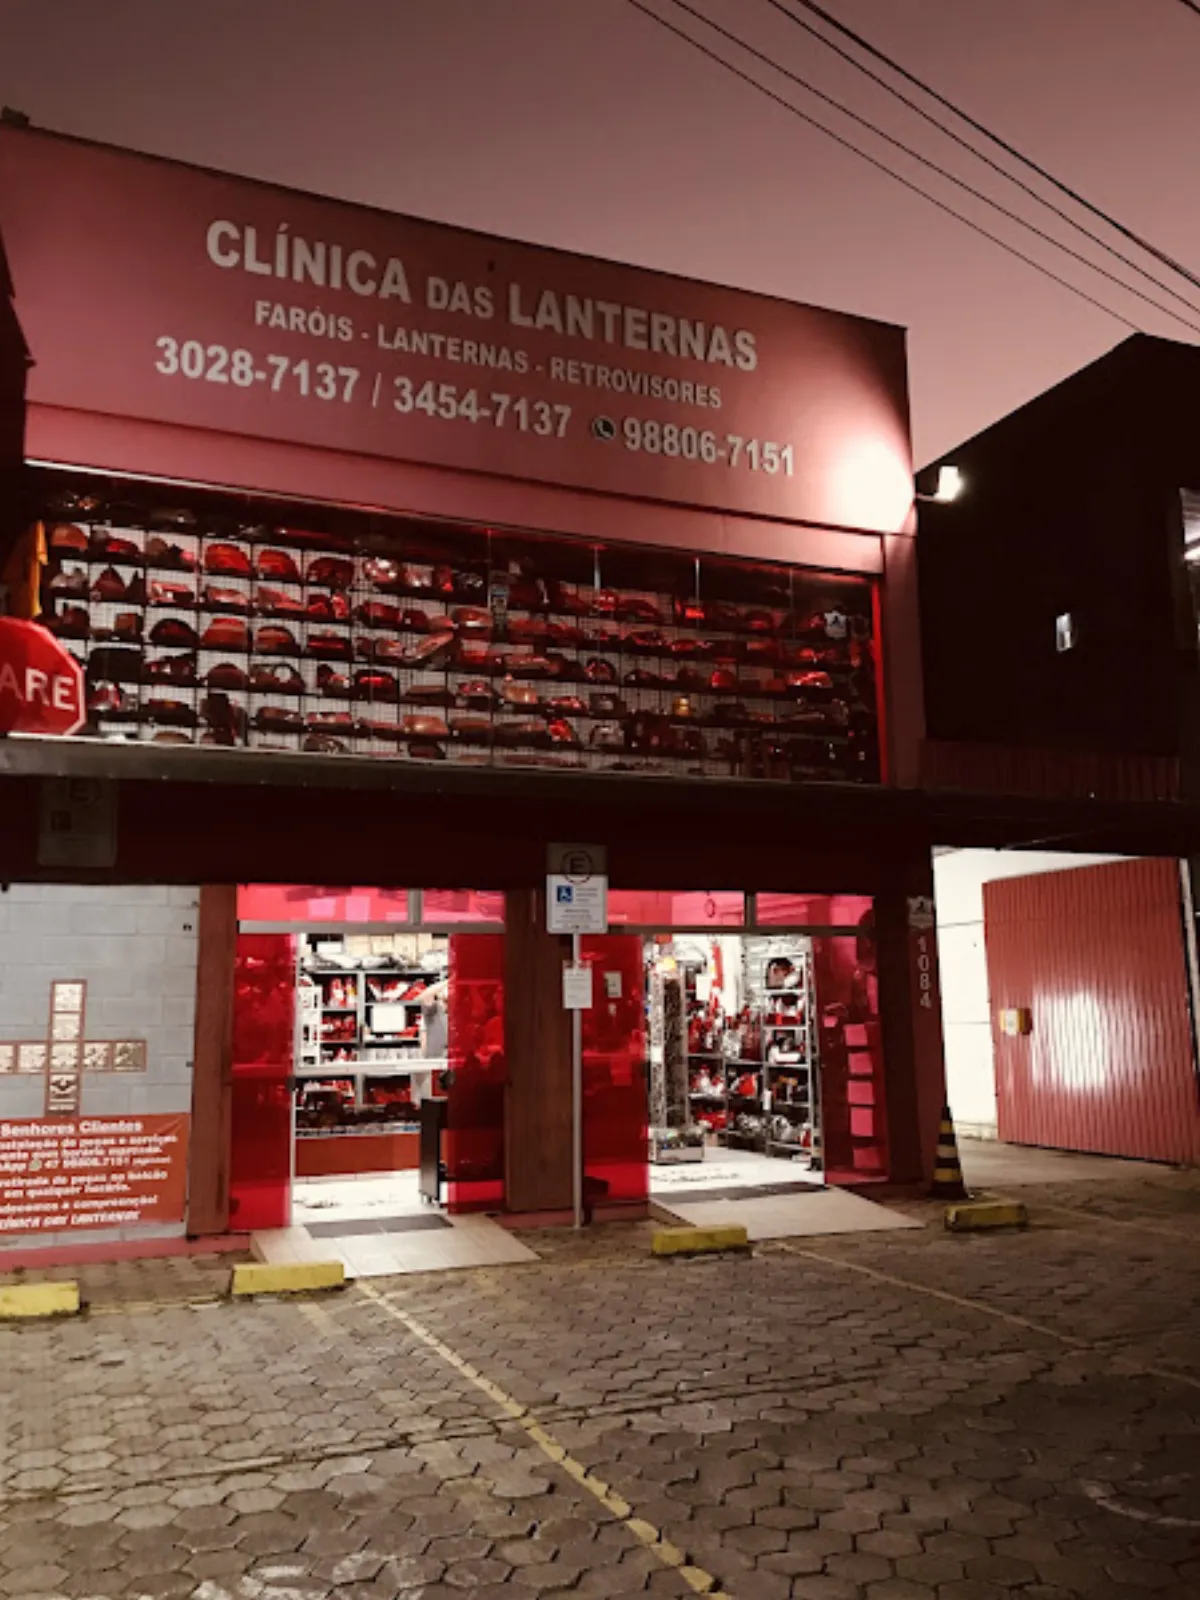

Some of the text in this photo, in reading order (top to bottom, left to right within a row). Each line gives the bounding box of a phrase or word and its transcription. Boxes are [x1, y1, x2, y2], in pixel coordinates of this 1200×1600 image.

[207, 219, 758, 371] CLÍNICA DAS LANTERNAS
[155, 335, 360, 403] 3028-7137
[393, 375, 572, 438] 3454-7137
[623, 416, 795, 477] 98806-7151
[255, 300, 353, 341] FARÓIS
[378, 323, 529, 375] LANTERNAS
[551, 356, 722, 409] RETROVISORES
[917, 936, 932, 1009] 1084
[1, 1120, 143, 1137] Senhores Clientes
